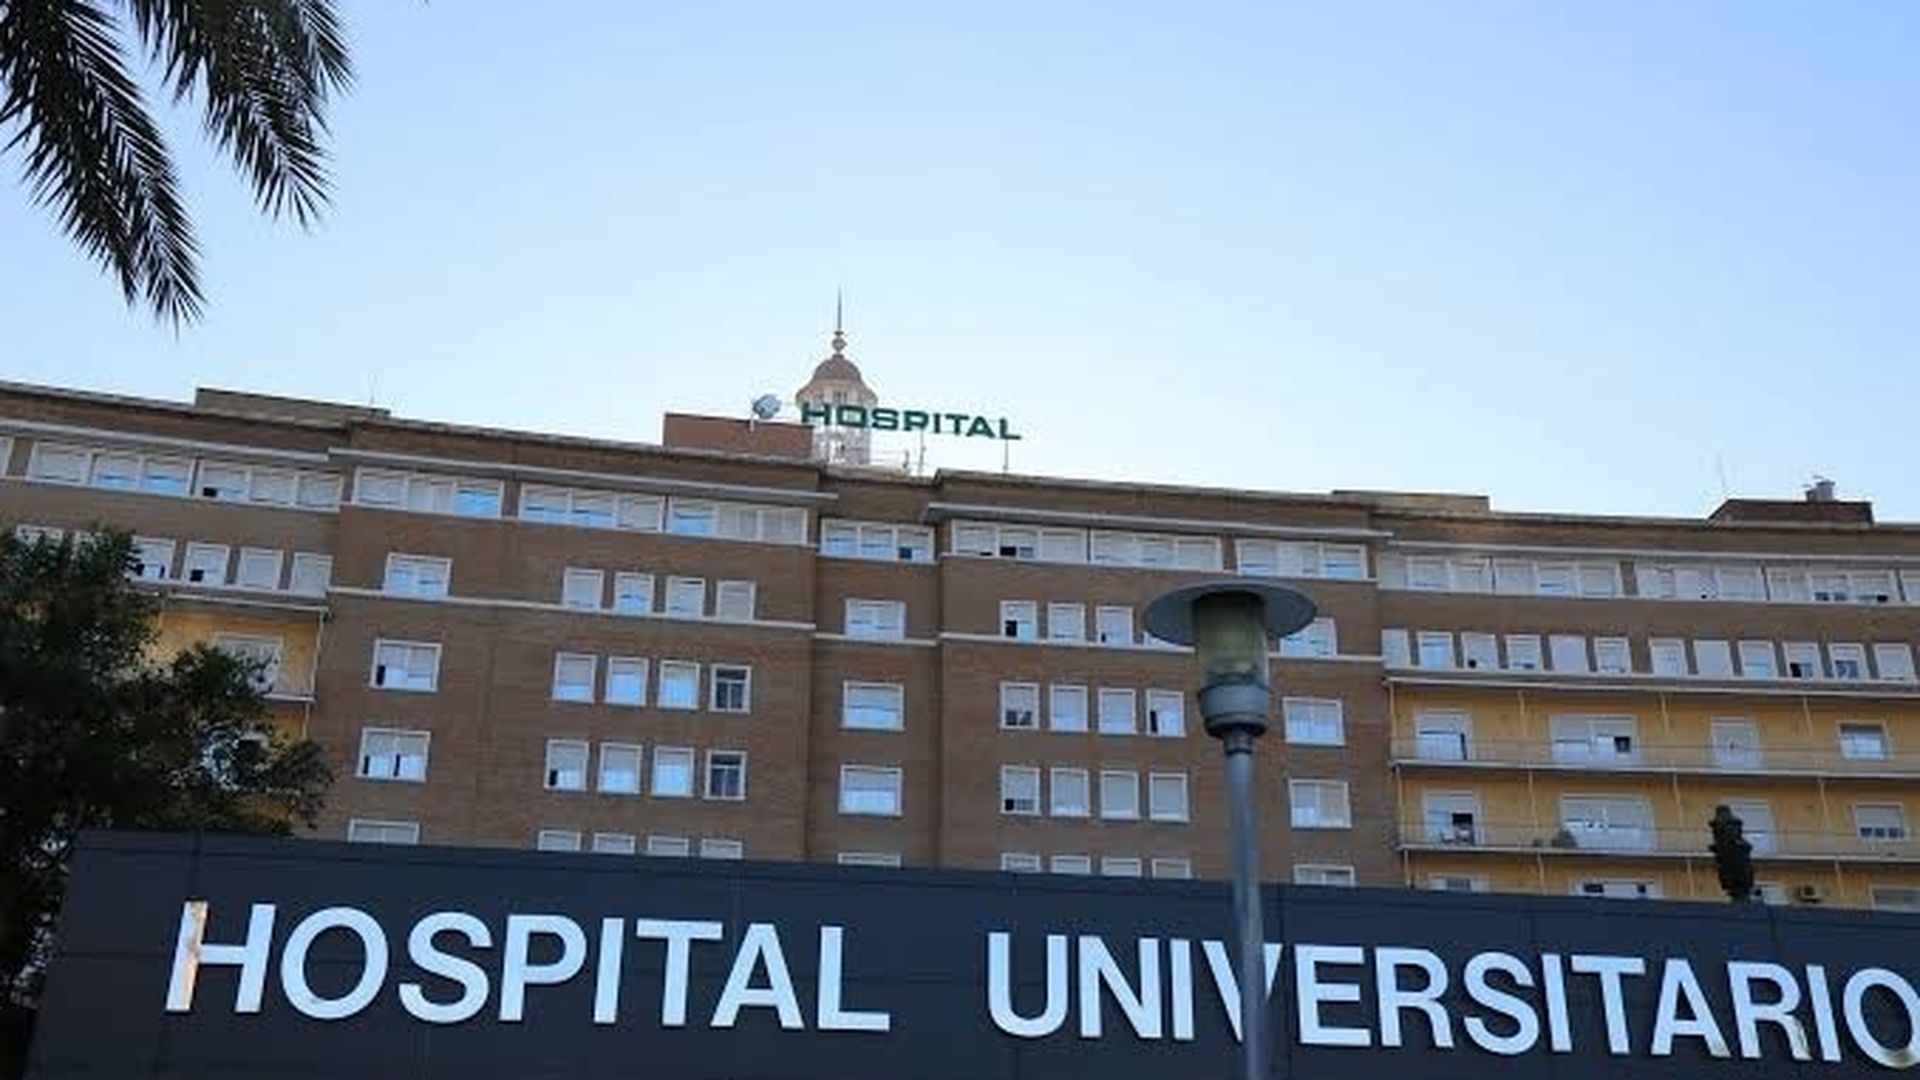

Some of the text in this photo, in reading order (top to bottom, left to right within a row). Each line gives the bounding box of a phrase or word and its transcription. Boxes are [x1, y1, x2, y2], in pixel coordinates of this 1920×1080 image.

[801, 402, 1022, 441] HOSPITAL
[165, 901, 1920, 1068] HOSPITAL UNIVERSITARIO
